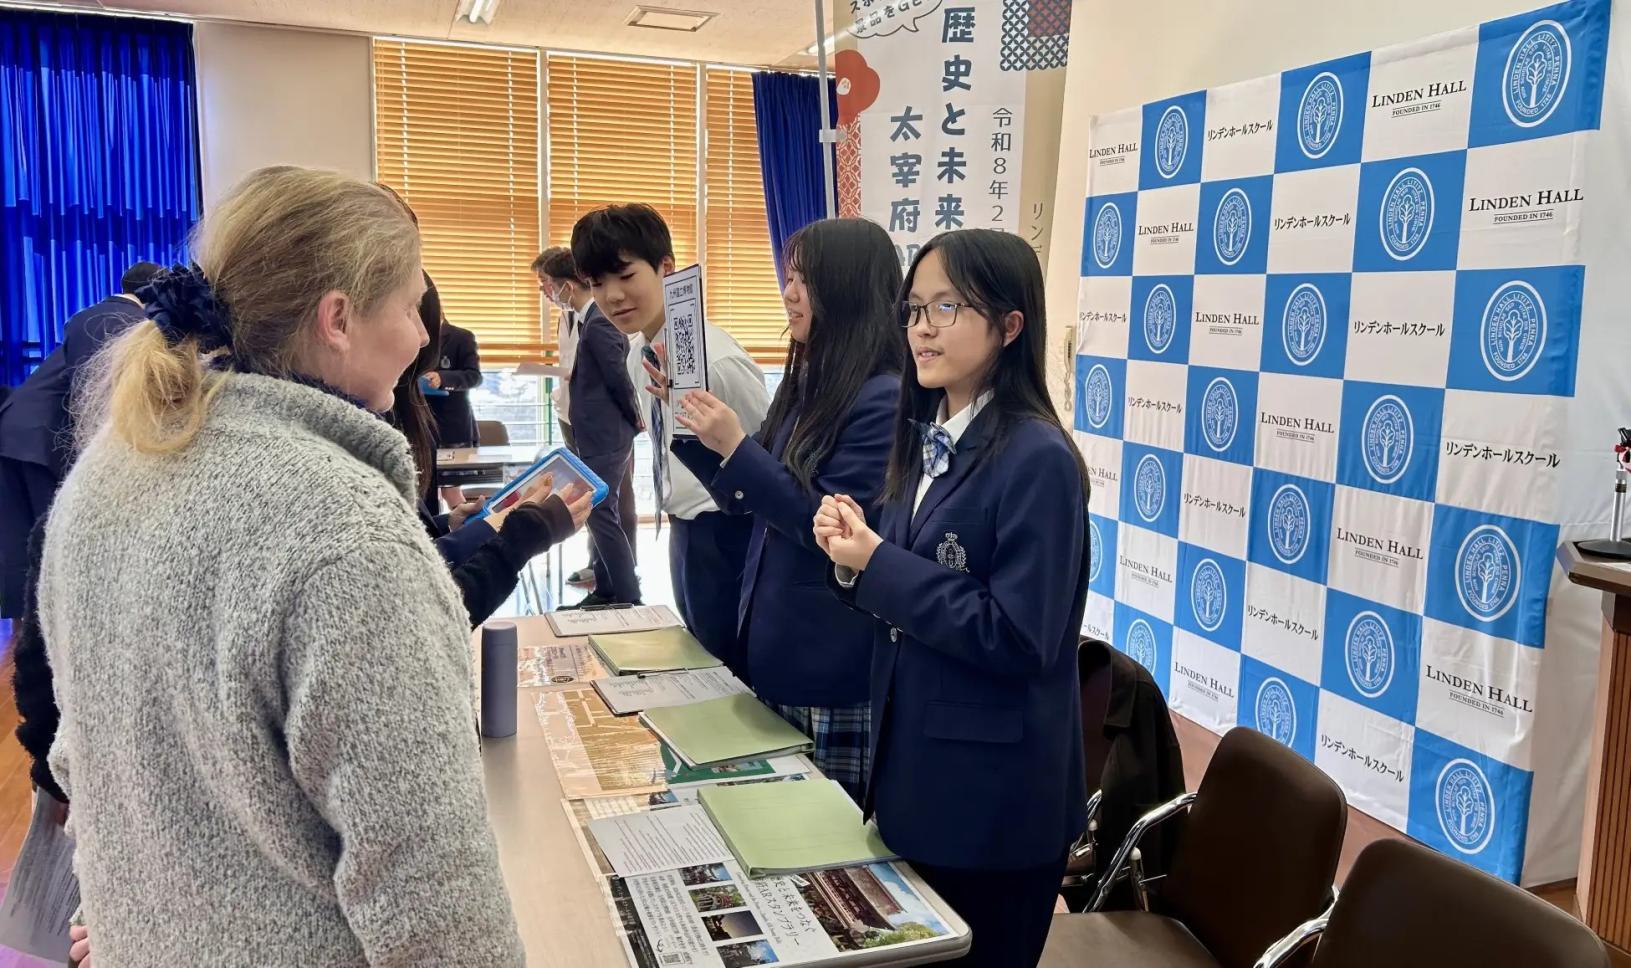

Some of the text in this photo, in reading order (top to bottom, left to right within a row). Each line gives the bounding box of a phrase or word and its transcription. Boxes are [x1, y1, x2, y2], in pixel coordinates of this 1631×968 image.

[1372, 80, 1467, 108] LINDEN HALL
[934, 7, 976, 230] 歴史と未来
[1207, 119, 1273, 142] リンデンホールスクール
[1089, 143, 1139, 159] LINDEN HALL
[988, 107, 1013, 233] 令和8年2
[1469, 188, 1584, 212] LINDEN HALL
[1138, 221, 1195, 236] LINDEN HALL
[1274, 212, 1351, 231] リンデンホールスクール
[1494, 214, 1529, 223] FOUNDED
[1195, 311, 1260, 326] LINDEN HALL
[1354, 320, 1446, 337] リンデンホールスクール
[1128, 396, 1182, 414] リンデンホールスクール
[1260, 411, 1335, 434] LINDEN HALL
[1445, 441, 1561, 469] リンデンホールスクール
[1184, 492, 1247, 519] リンデンホールスクール
[1336, 527, 1424, 560] LINDEN HALL
[1119, 555, 1149, 574] LINDEN
[1151, 566, 1173, 583] HALL
[1247, 604, 1319, 641] リンデンホールスクール
[1174, 661, 1208, 686] LINDEN
[1210, 677, 1235, 698] HALL
[1425, 664, 1534, 713] LINDEN HALL
[1449, 692, 1480, 708] FOUNDED
[1321, 733, 1405, 783] リンデンホールスクール
